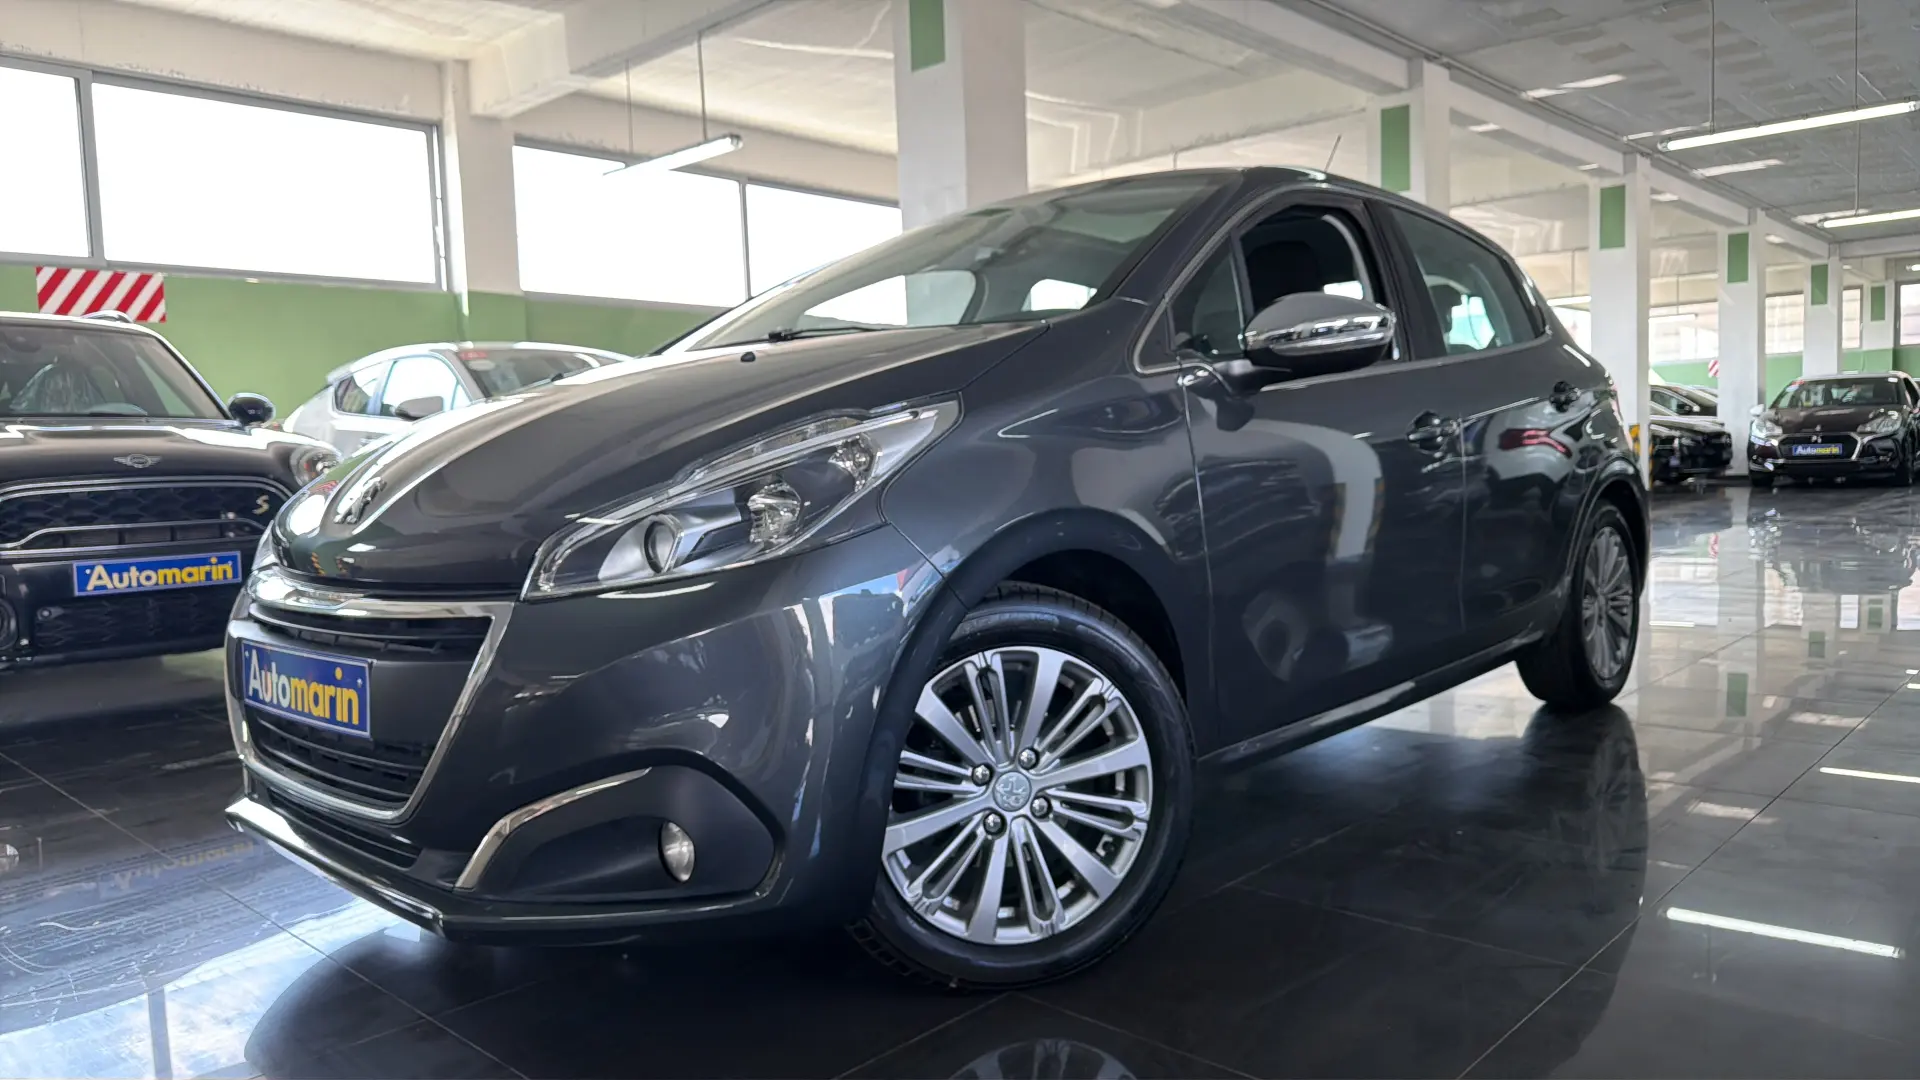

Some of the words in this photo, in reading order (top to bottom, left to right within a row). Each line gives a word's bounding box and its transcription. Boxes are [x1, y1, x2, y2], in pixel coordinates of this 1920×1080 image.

[252, 494, 269, 515] S
[86, 556, 233, 591] Automarin
[248, 648, 359, 725] Automarin
